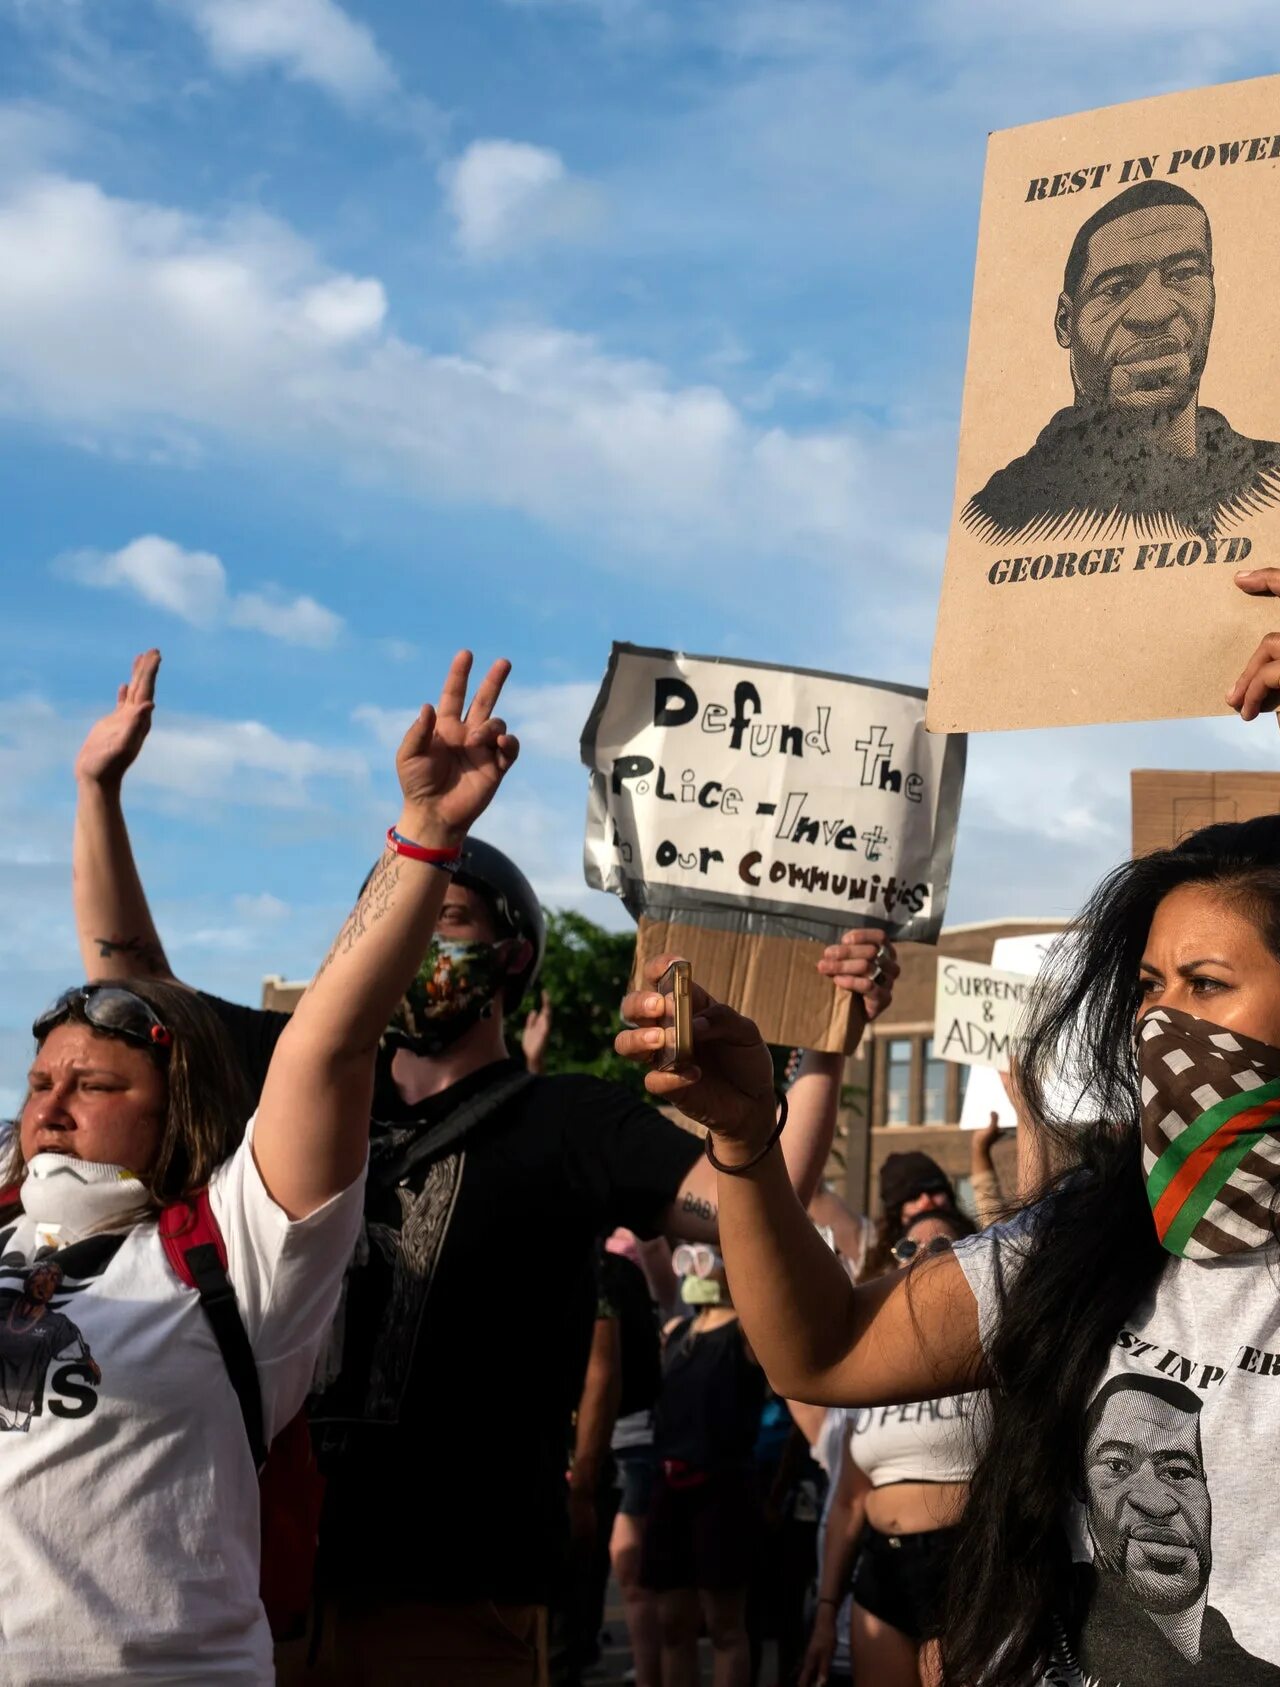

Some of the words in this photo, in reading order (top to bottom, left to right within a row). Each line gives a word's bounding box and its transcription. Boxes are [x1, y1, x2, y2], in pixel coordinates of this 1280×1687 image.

[1025, 163, 1111, 203] REST
[1118, 156, 1160, 184] IN
[988, 547, 1124, 585] GEORGE
[1134, 537, 1252, 571] FLOYD
[654, 677, 831, 758] Defund
[855, 725, 924, 802] the
[655, 839, 724, 875] our
[943, 964, 1047, 1004] SURREND
[982, 1000, 995, 1023] &
[941, 1018, 1030, 1060] ADM
[1117, 1331, 1159, 1357] ST
[1154, 1349, 1198, 1383] IN
